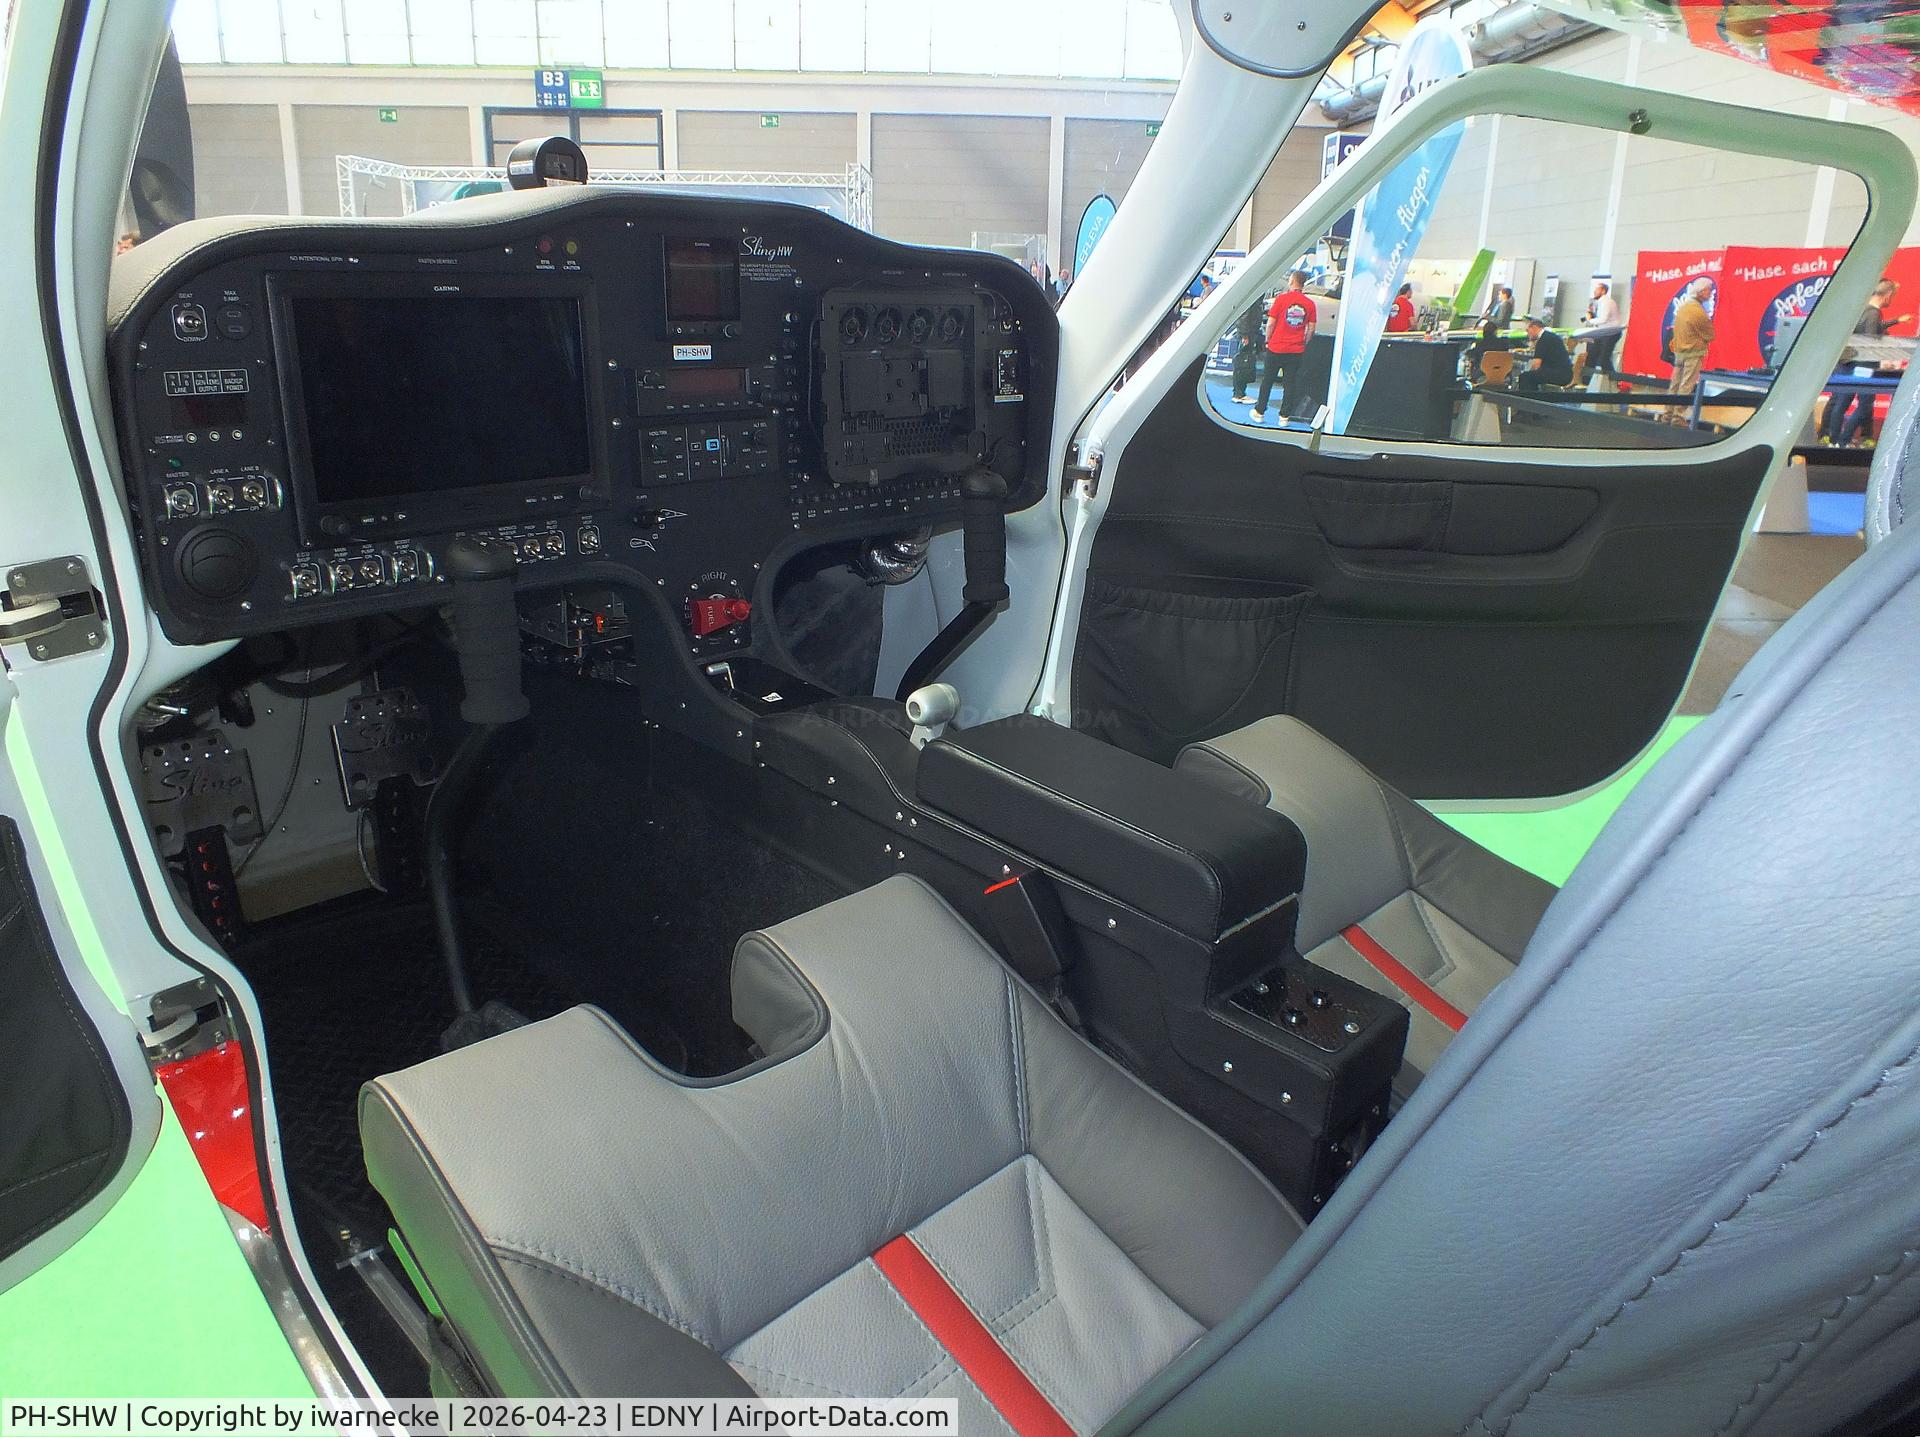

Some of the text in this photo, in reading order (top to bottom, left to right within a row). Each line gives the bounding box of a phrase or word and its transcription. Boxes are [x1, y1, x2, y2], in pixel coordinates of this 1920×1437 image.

[542, 71, 564, 87] B3
[1396, 166, 1431, 233] fliegen
[740, 236, 793, 261] Sling HW
[1078, 215, 1104, 264] EFLEVA
[1792, 255, 1827, 274] sach
[676, 347, 709, 357] PH-SHW
[701, 570, 728, 583] RIGHT
[706, 605, 715, 627] FUEL
